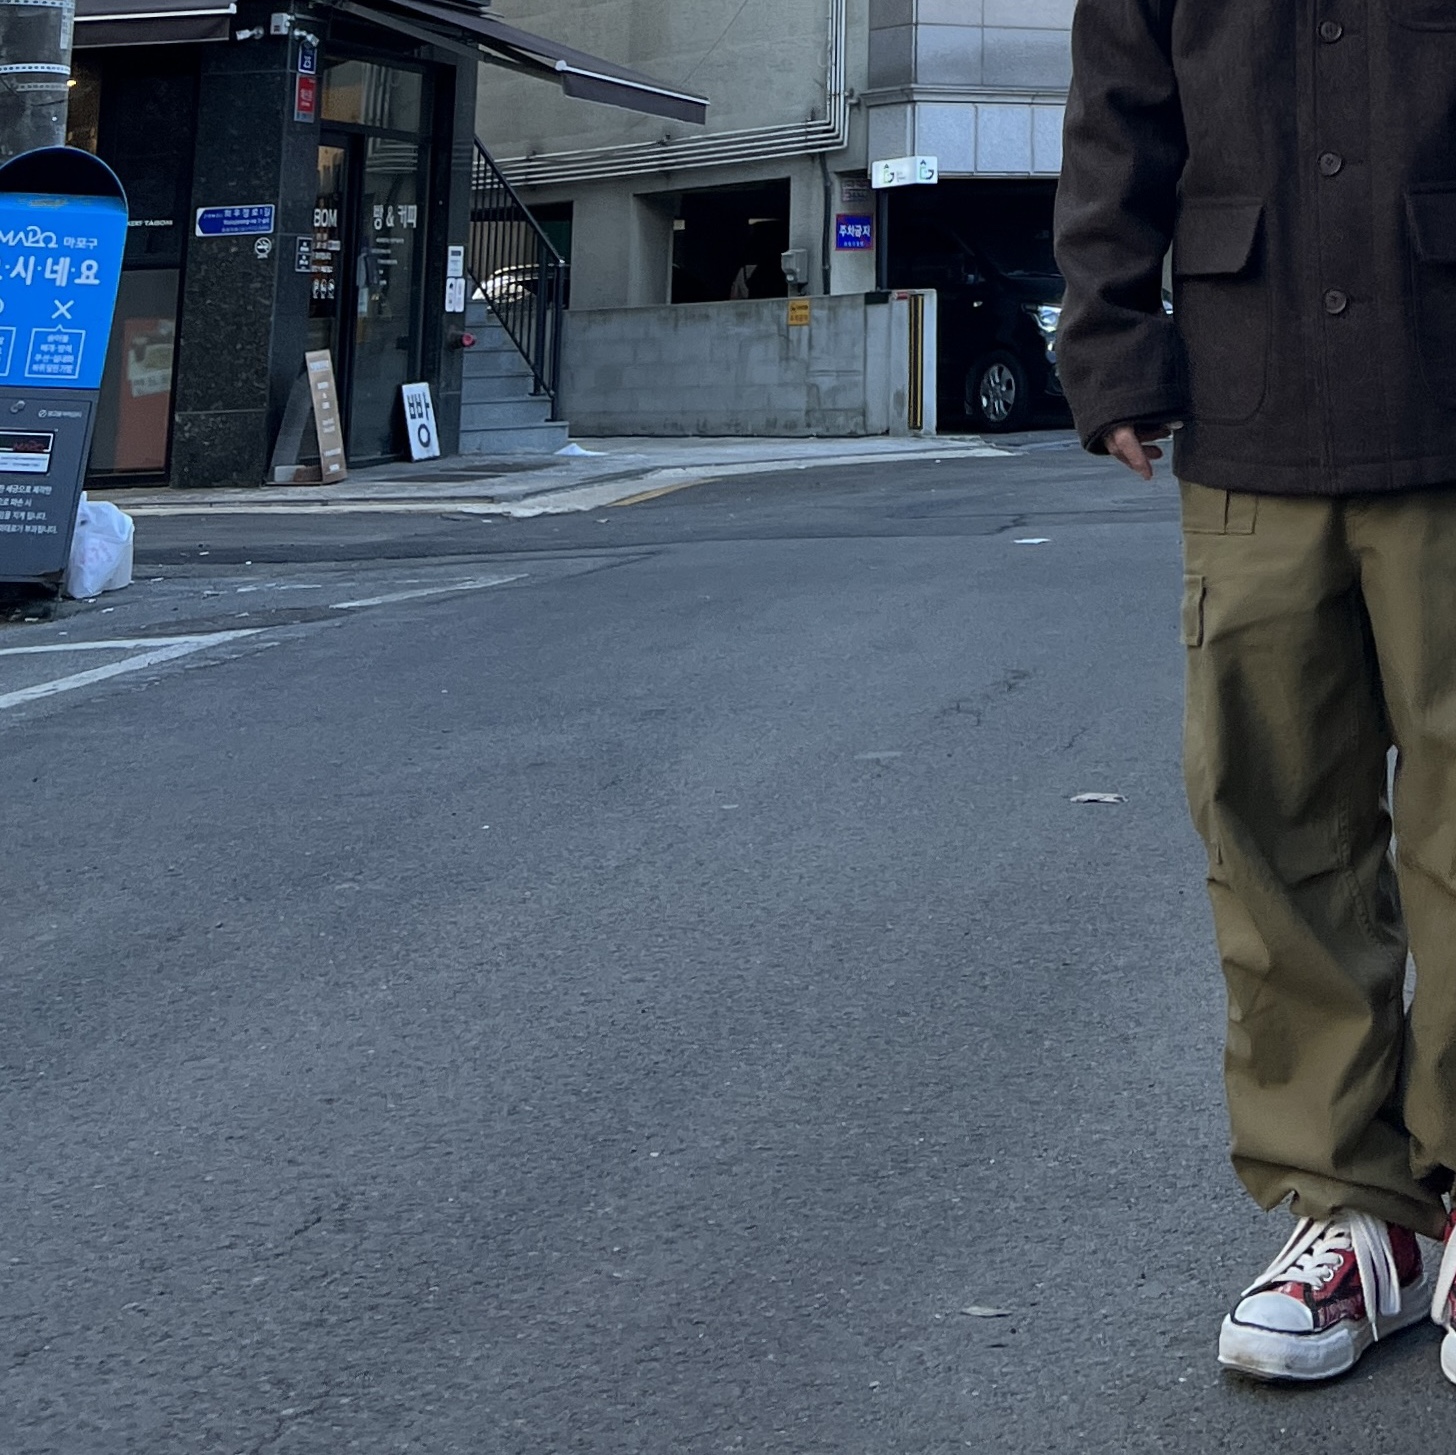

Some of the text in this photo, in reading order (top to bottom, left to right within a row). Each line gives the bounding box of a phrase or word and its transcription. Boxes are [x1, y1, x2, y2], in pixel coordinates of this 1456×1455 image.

[385, 205, 395, 228] &
[397, 204, 418, 229] 커피
[838, 224, 871, 238] 주차금지
[63, 236, 98, 250] 마포구
[406, 391, 431, 448] 빵
